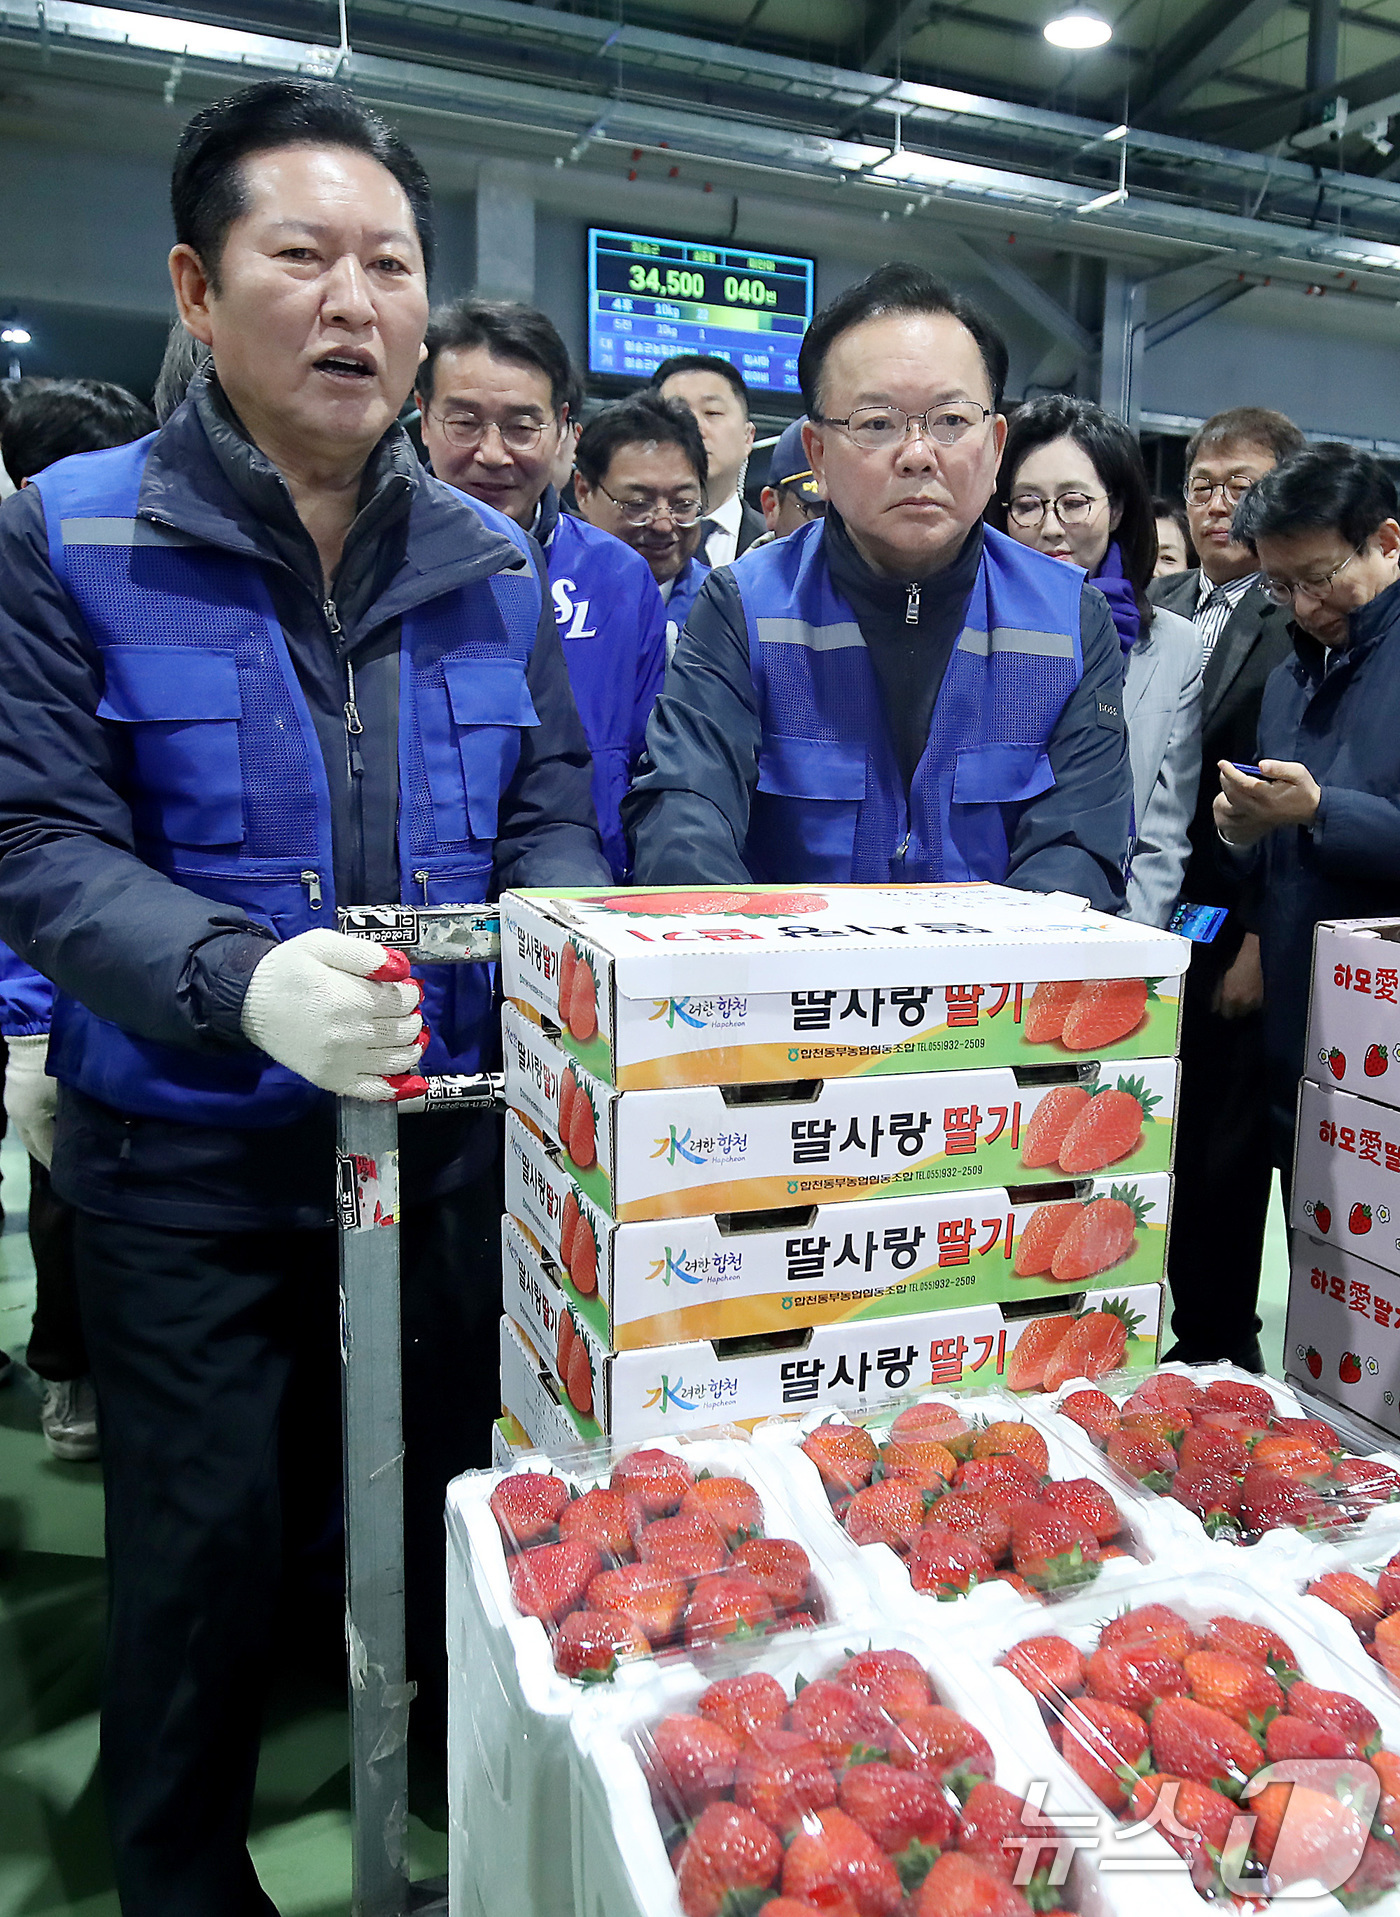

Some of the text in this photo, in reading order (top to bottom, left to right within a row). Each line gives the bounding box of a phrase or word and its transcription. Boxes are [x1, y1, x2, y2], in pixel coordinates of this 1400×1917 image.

[628, 265, 705, 299] 34,500
[717, 996, 748, 1018] 합천
[791, 982, 1023, 1031] 딸사랑 딸기
[711, 1019, 747, 1030] Hapcheon
[717, 1132, 748, 1154] 합천
[791, 1101, 1022, 1165] 딸사랑 딸기
[711, 1155, 747, 1165] Hapcheon
[785, 1213, 1016, 1281] 딸사랑 딸기
[711, 1252, 743, 1274] 합천
[706, 1274, 742, 1285] Hapcheon
[780, 1329, 1007, 1403] 딸사랑 딸기
[708, 1377, 739, 1397] 합천
[703, 1399, 737, 1410] Hapcheon
